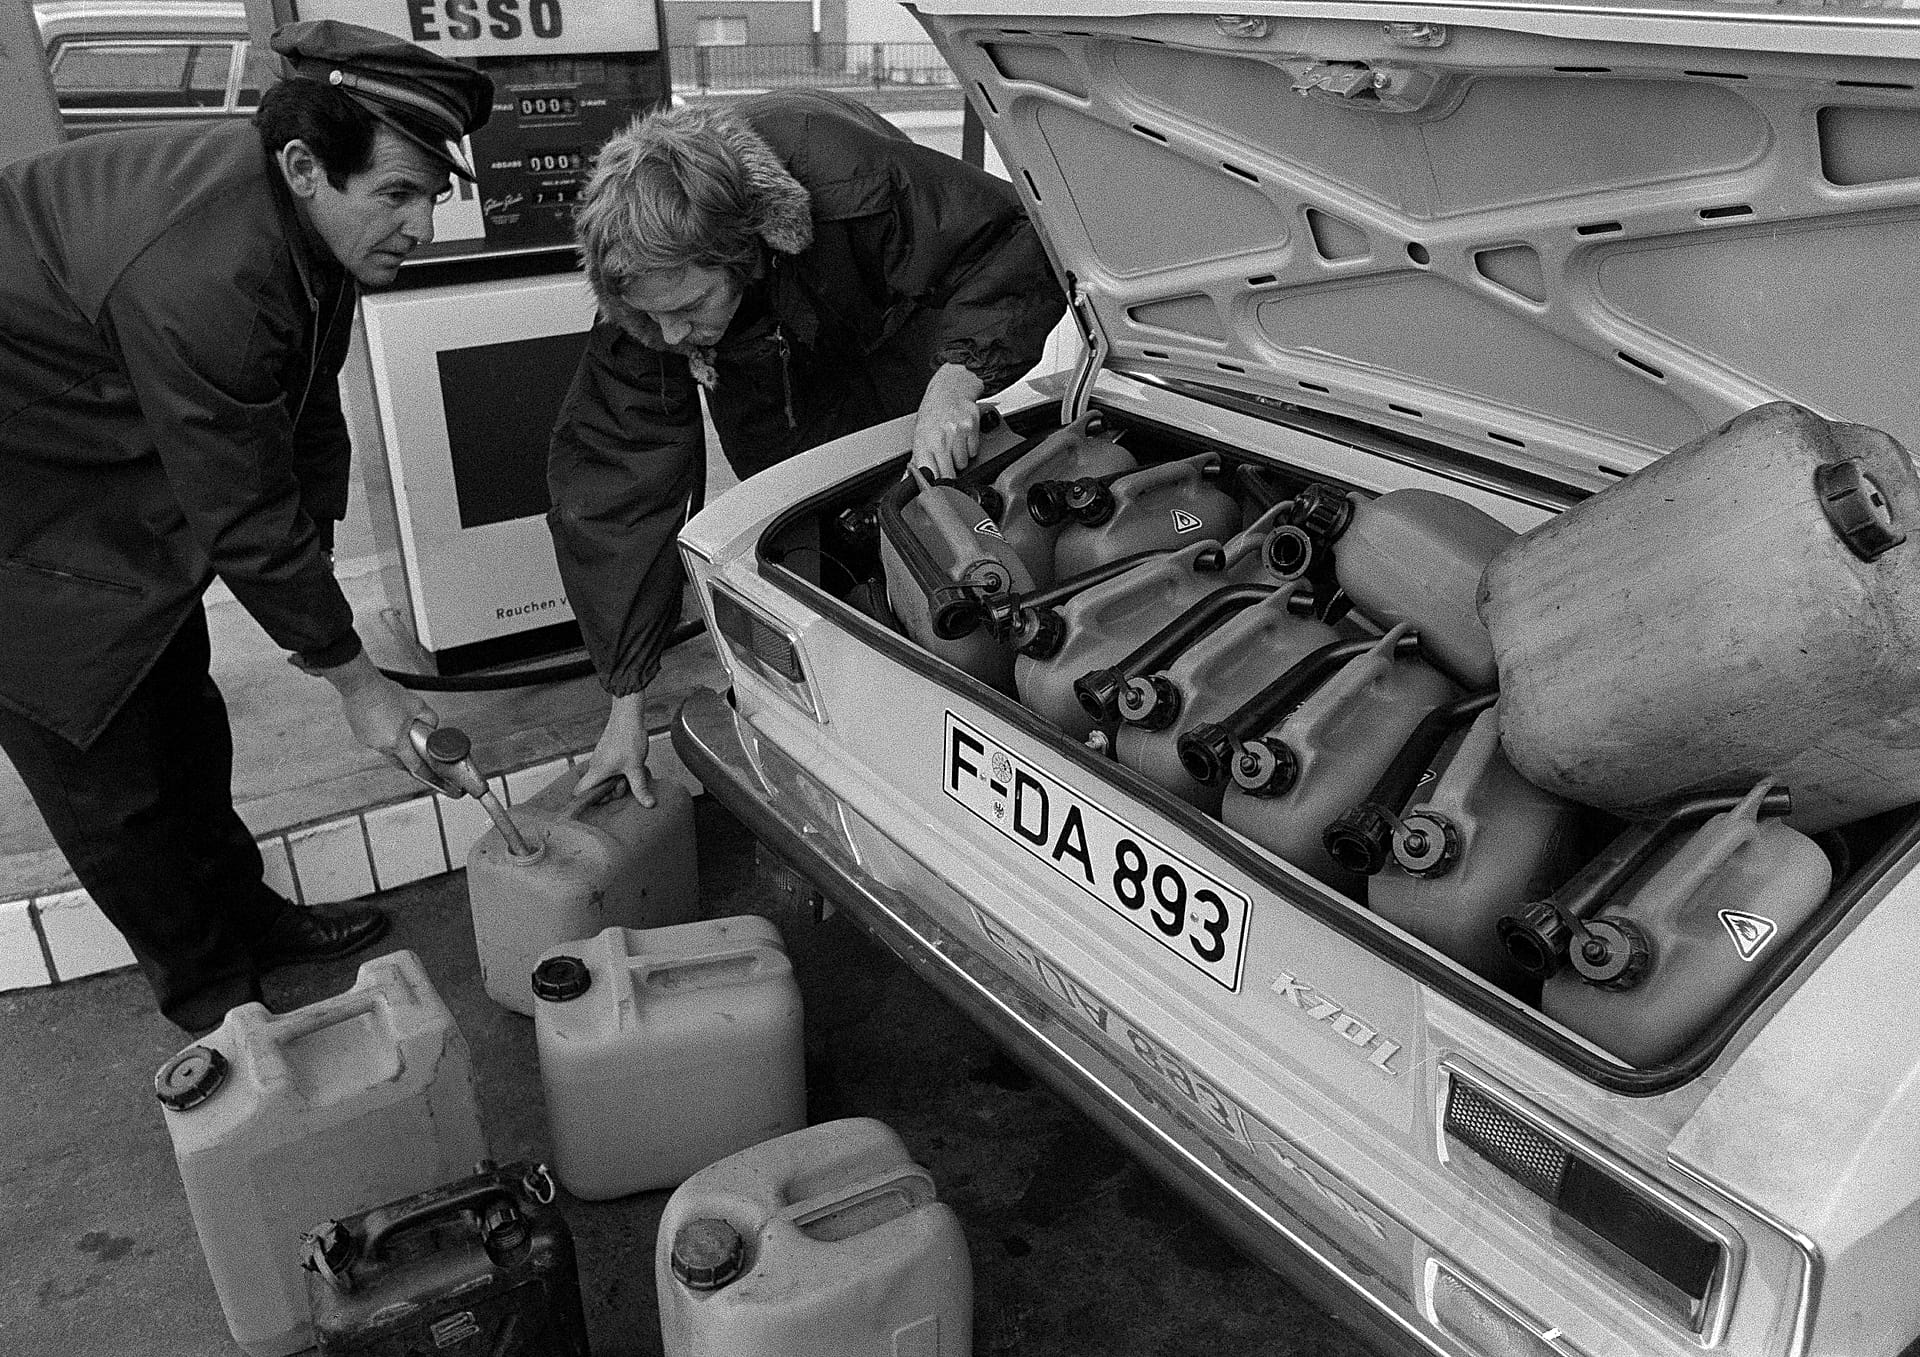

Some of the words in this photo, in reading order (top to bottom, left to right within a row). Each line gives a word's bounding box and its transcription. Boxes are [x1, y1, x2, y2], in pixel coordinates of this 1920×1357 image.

[407, 0, 562, 40] ESSO
[496, 599, 556, 619] Rauchen
[950, 727, 1096, 885] F-DA
[1113, 839, 1230, 962] 893
